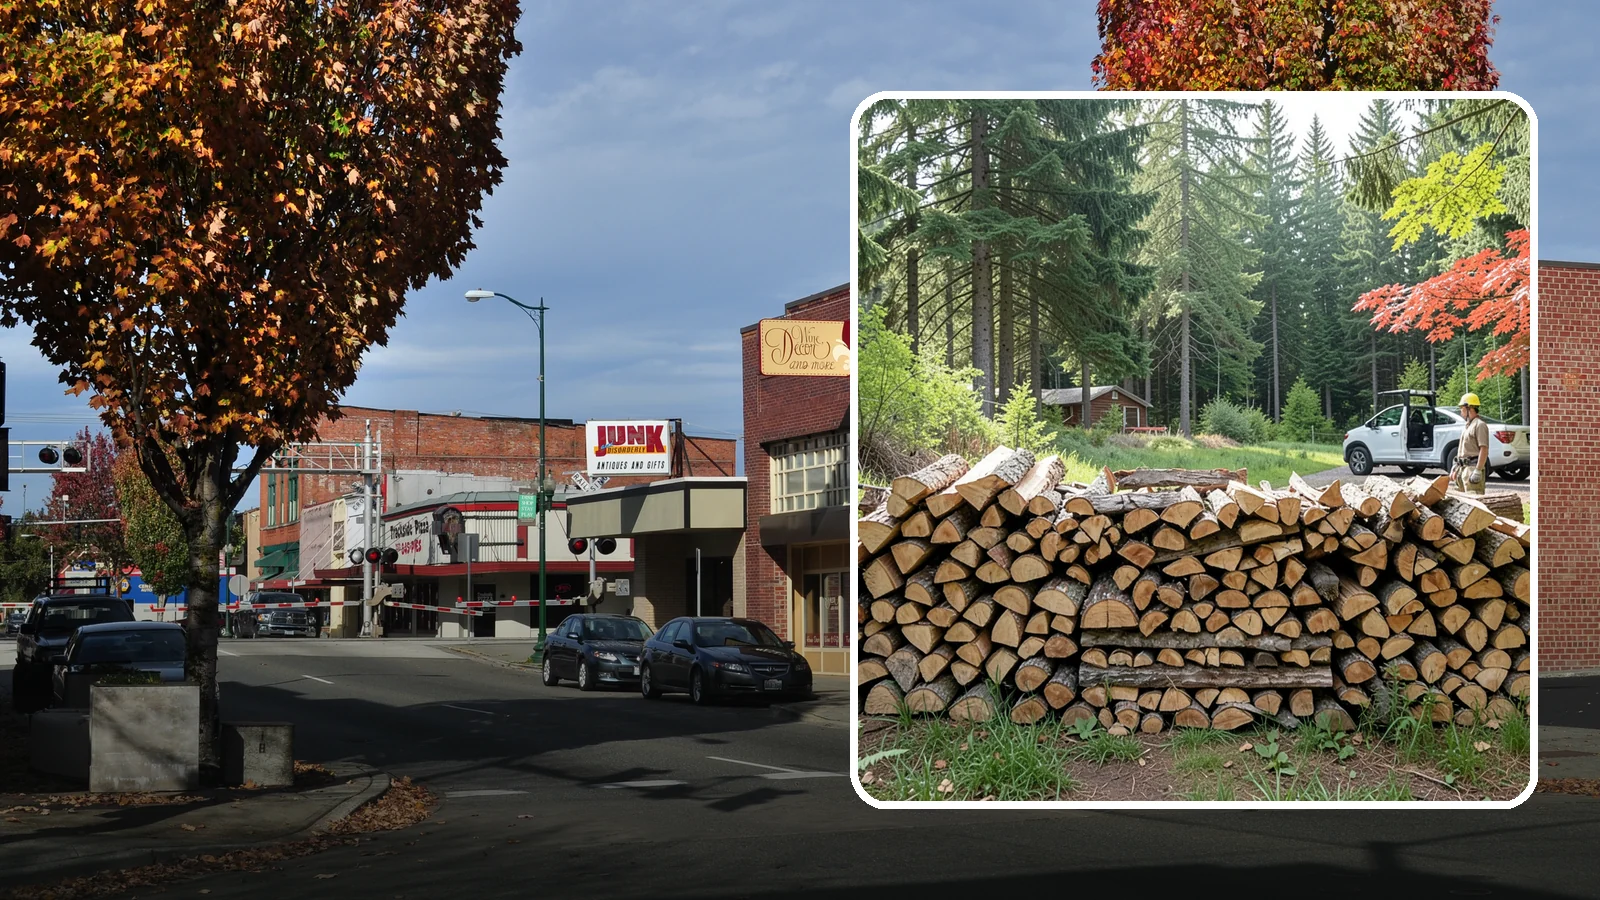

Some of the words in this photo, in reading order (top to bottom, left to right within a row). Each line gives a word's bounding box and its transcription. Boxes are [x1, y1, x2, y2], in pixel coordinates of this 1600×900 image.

[595, 424, 666, 457] JUNK
[607, 445, 646, 454] DISORDERLY
[596, 461, 628, 470] ANTIQUES
[631, 461, 644, 470] AND
[646, 460, 666, 470] GIFTS
[414, 519, 429, 535] Pizza
